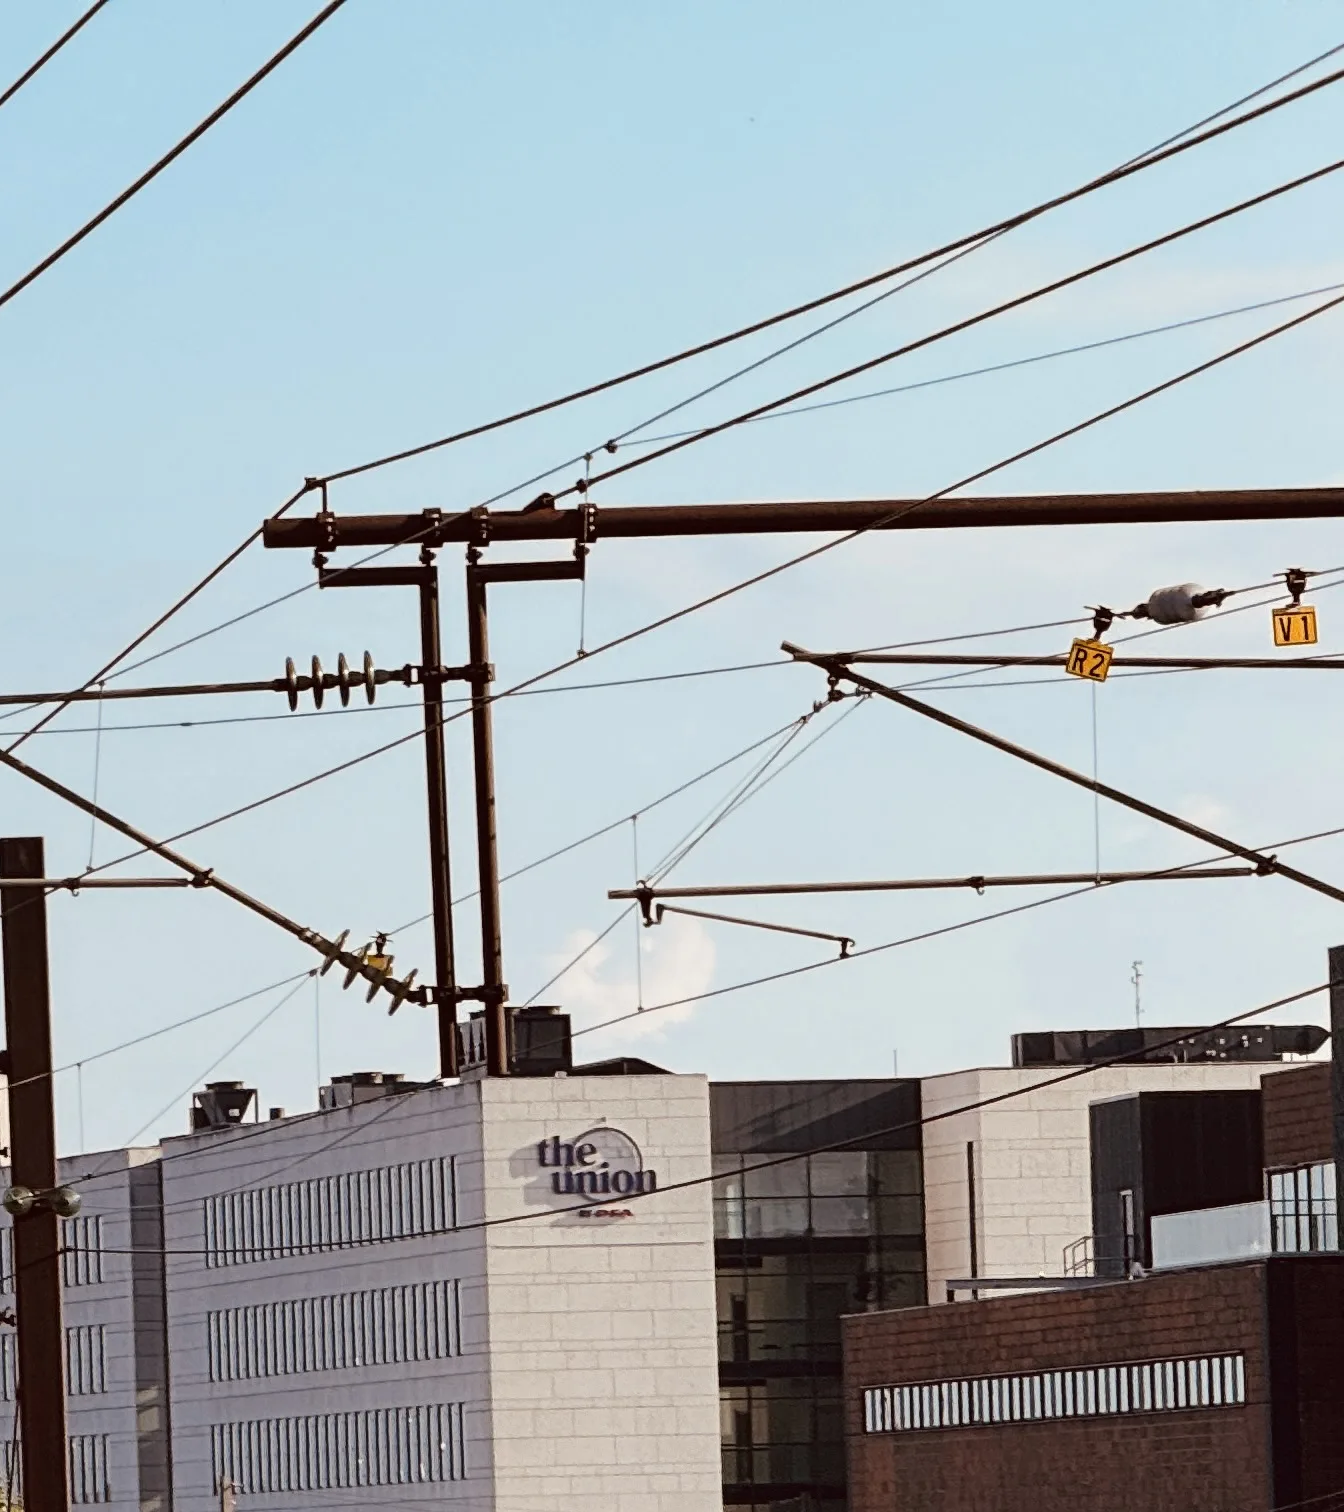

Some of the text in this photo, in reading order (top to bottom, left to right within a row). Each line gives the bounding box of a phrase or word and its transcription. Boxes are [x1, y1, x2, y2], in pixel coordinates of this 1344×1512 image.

[1278, 615, 1309, 642] V1
[1072, 648, 1105, 678] R2
[537, 1135, 598, 1167] the
[551, 1161, 657, 1194] union
